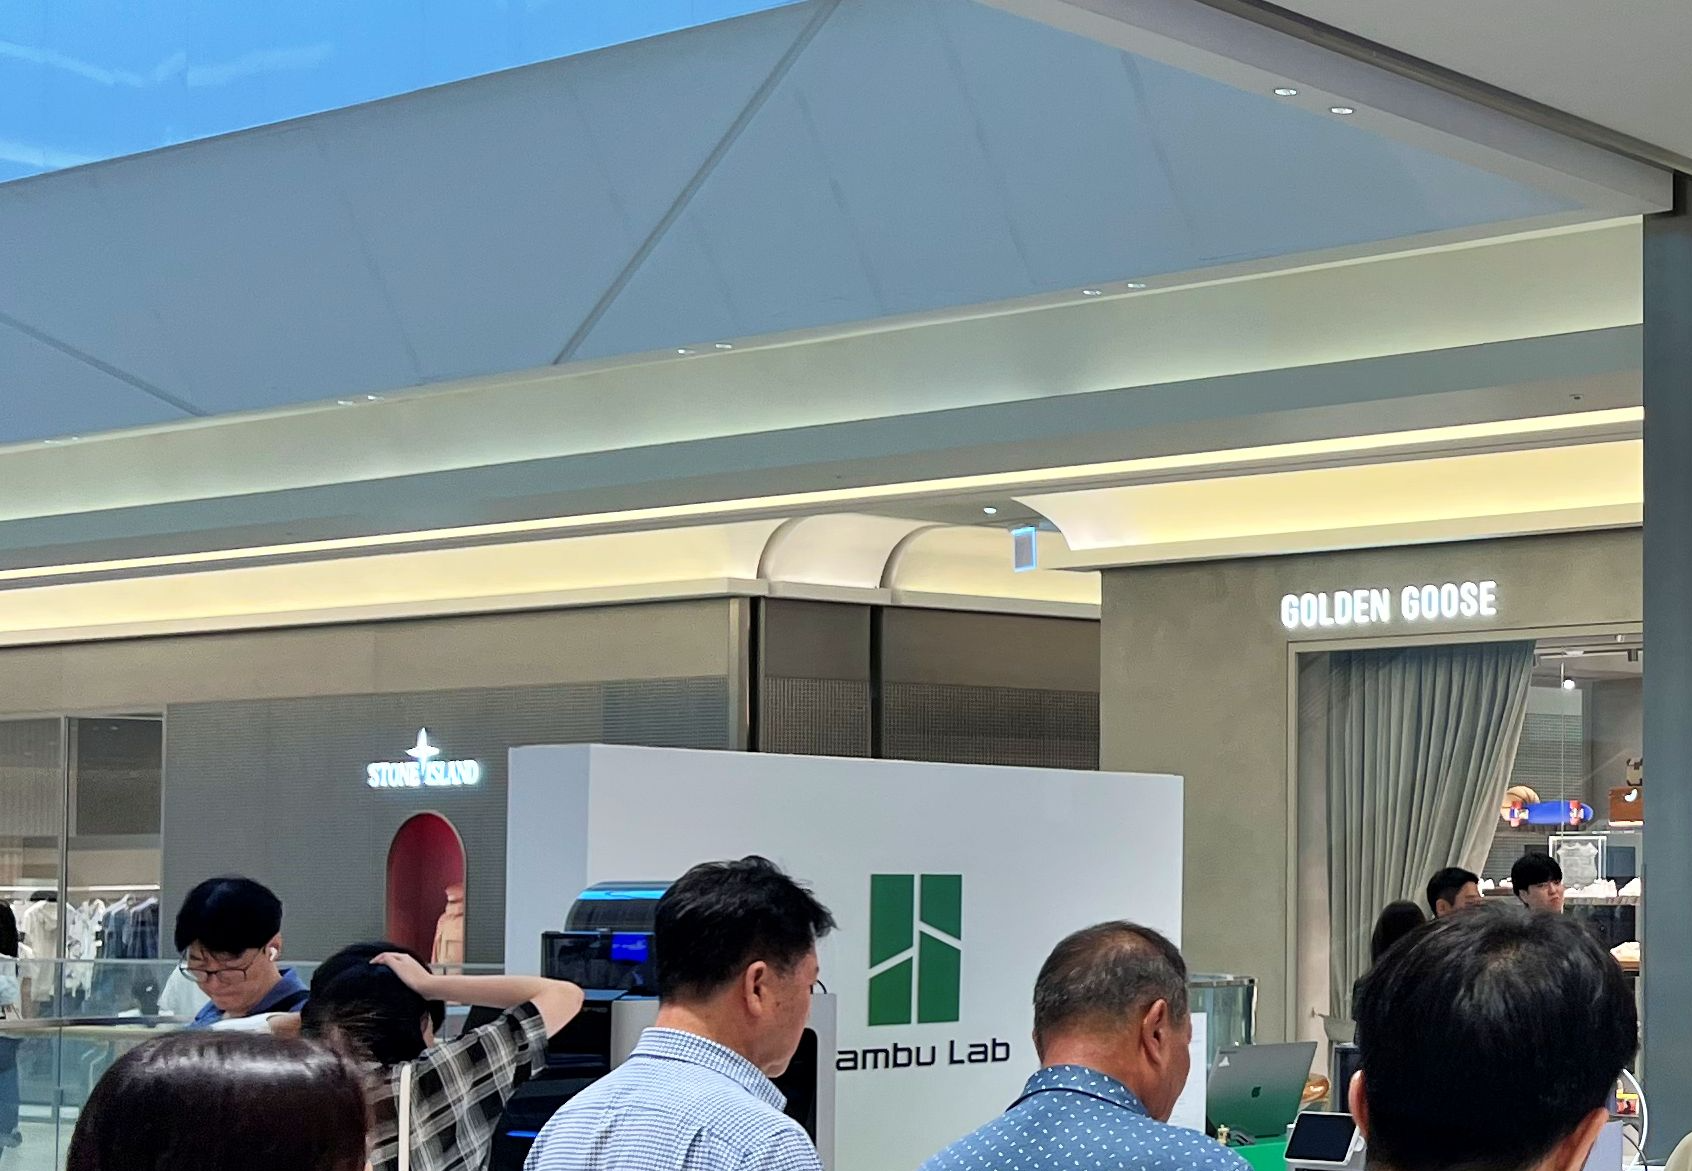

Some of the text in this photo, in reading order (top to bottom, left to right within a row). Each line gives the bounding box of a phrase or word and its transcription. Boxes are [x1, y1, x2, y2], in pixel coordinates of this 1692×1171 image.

[1281, 580, 1498, 629] GOLDEN GOOSE
[367, 759, 480, 788] STONE ISLAND
[836, 1037, 1011, 1071] ambu Lab
